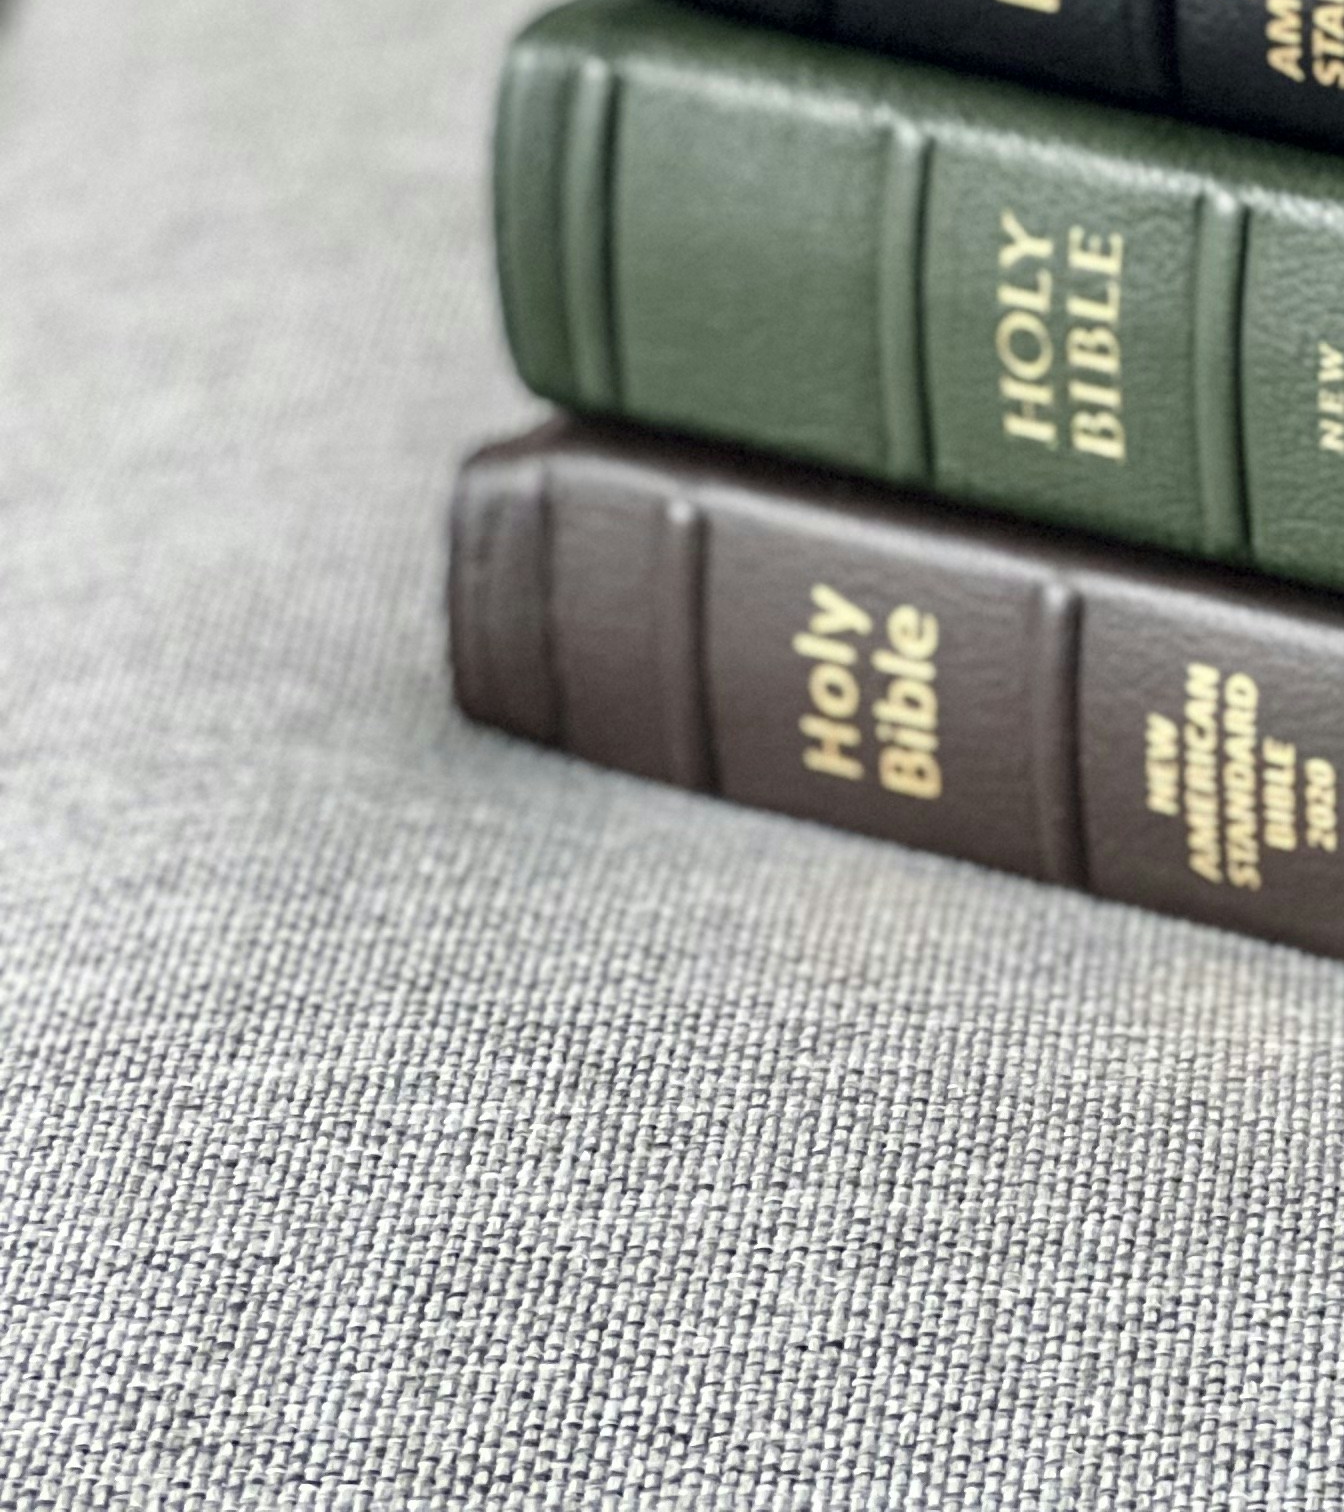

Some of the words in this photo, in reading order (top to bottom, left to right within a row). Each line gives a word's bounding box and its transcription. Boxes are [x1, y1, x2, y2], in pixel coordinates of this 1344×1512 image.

[995, 207, 1058, 445] HOLY
[1065, 224, 1126, 462] BIBLE
[792, 584, 872, 780] Holy
[871, 604, 942, 801] Bible
[1145, 712, 1178, 816] NEW
[1185, 662, 1221, 885] AMERICAN
[1223, 672, 1262, 891] STANDARD
[1262, 738, 1297, 851] BIBLE
[1303, 758, 1338, 853] 2020
